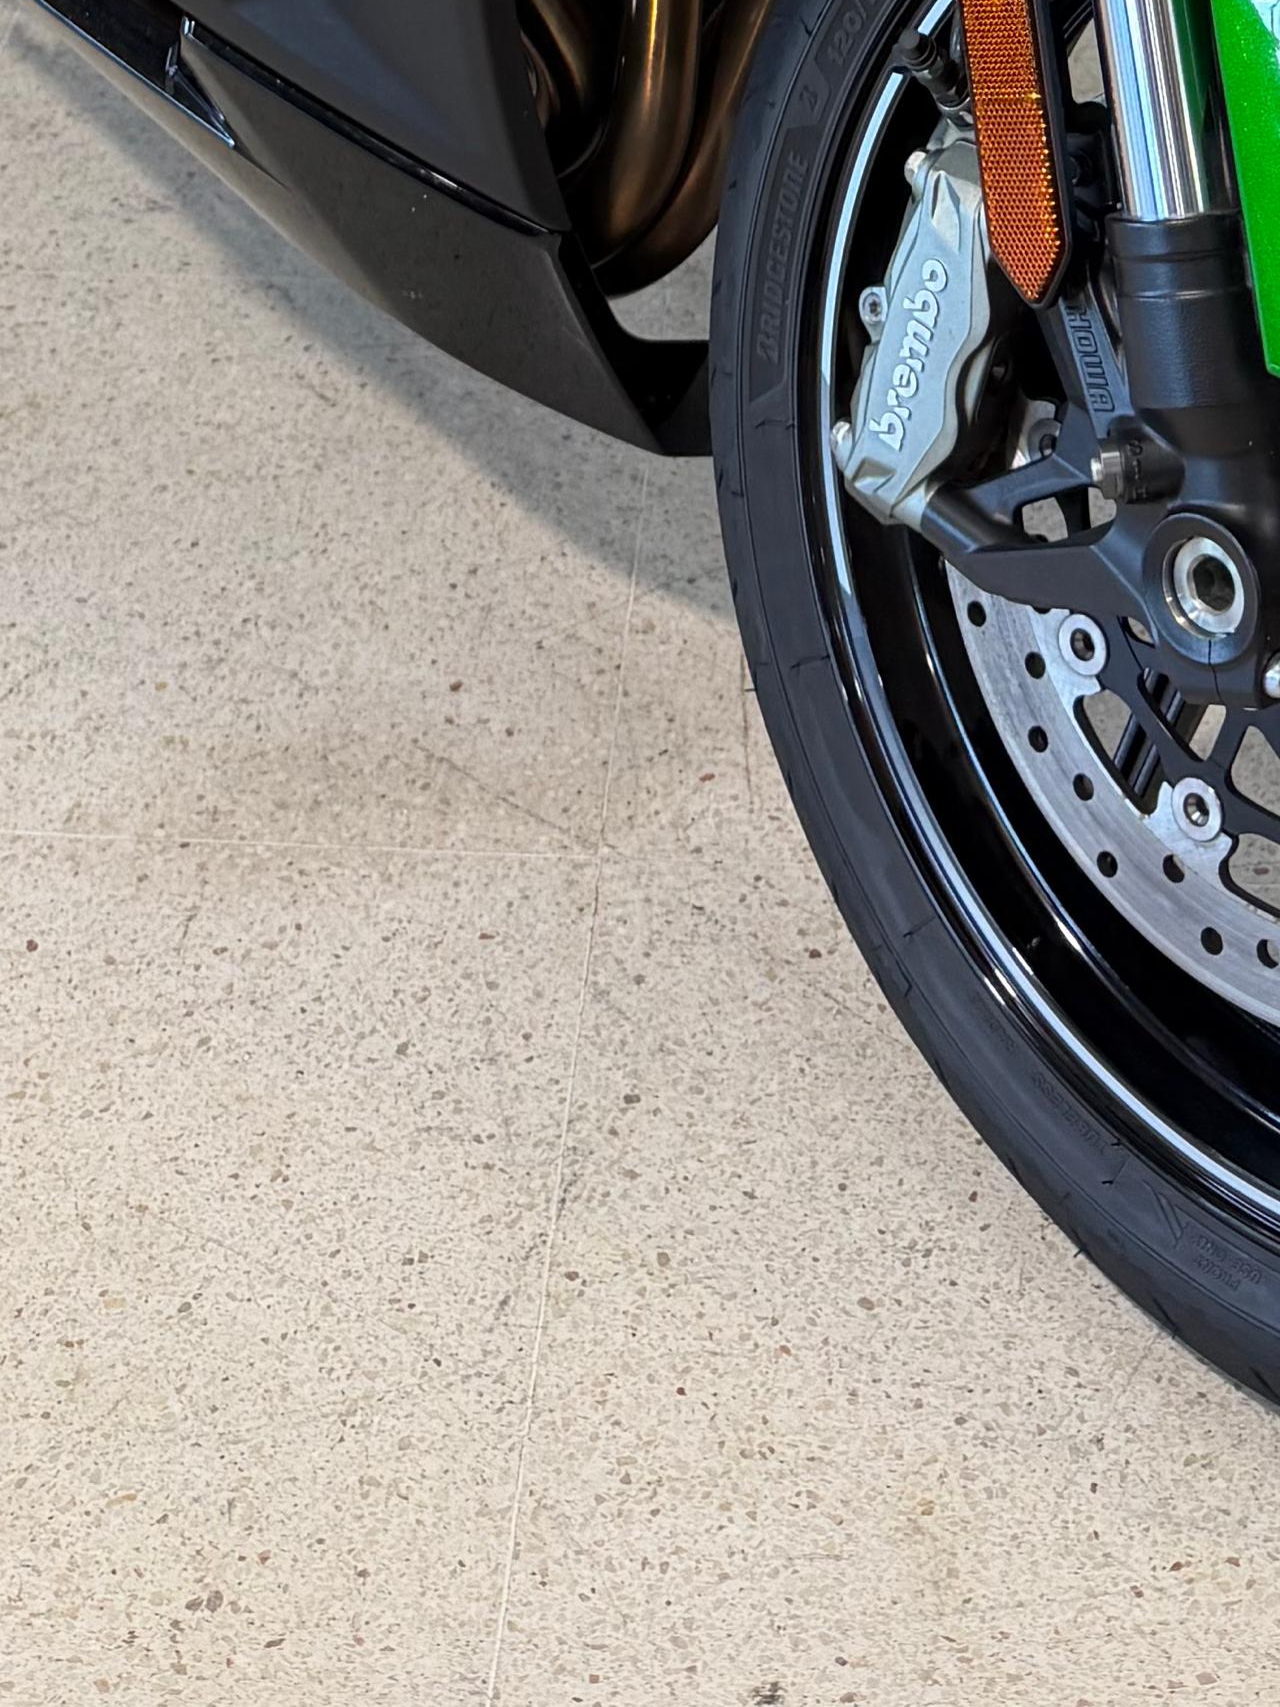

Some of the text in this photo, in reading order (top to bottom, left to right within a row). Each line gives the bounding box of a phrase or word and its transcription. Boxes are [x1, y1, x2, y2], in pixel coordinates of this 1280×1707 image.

[755, 147, 811, 368] BRIDGESTONE
[868, 257, 949, 452] brembo
[1064, 304, 1116, 414] HOWA
